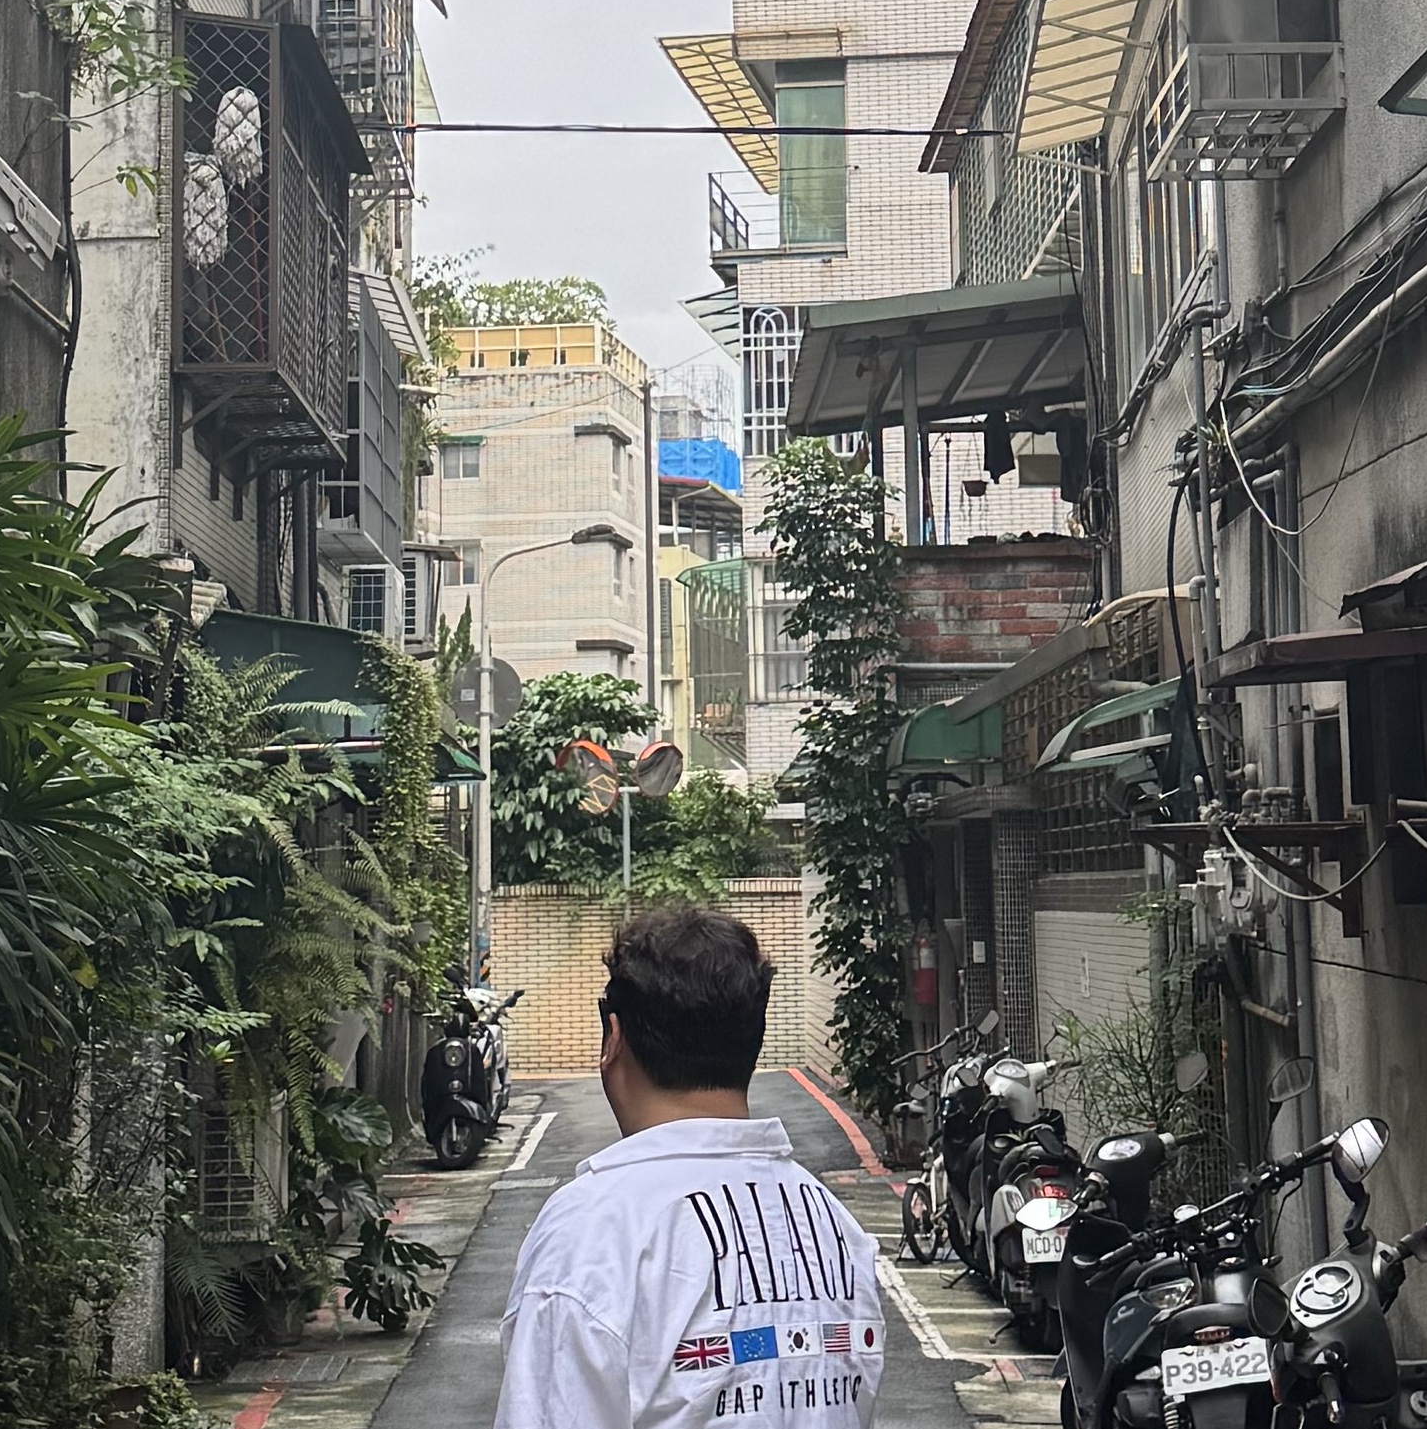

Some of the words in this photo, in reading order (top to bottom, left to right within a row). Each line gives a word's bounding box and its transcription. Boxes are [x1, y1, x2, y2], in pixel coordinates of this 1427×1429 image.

[685, 1181, 856, 1312] PALACE
[1165, 1352, 1268, 1387] P39-422
[715, 1383, 763, 1418] GAP
